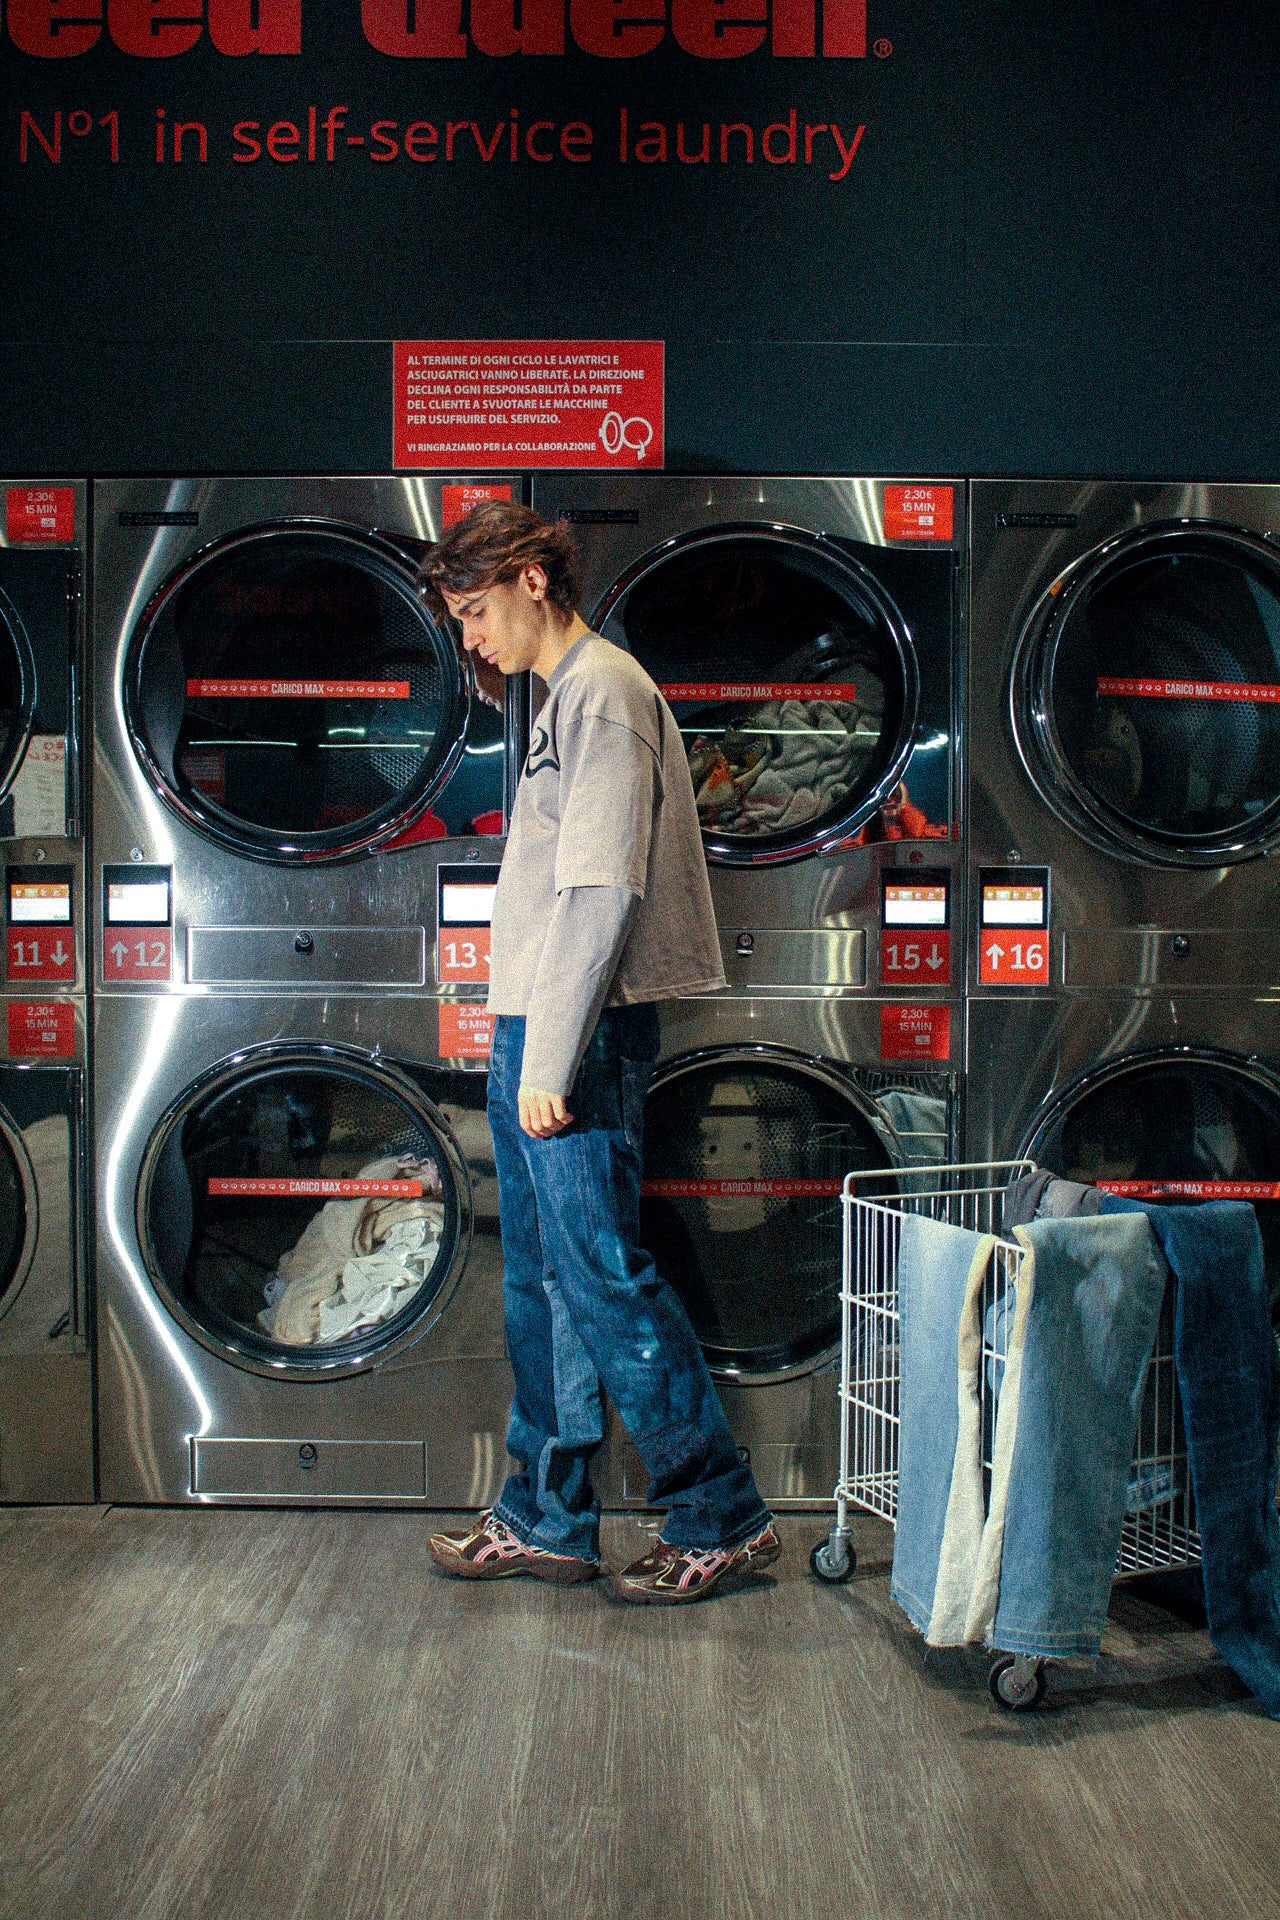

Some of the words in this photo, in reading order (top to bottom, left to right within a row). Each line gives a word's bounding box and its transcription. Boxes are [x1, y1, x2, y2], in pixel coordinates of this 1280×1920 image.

[155, 107, 208, 163] in
[232, 105, 595, 163] self-service
[619, 106, 866, 180] laundry
[407, 355, 421, 366] AL
[422, 355, 468, 365] TERMINE
[470, 355, 481, 365] DI
[483, 355, 510, 365] OGNI
[512, 355, 542, 365] CICLO
[544, 355, 556, 365] LE
[558, 355, 611, 365] LAVATRICI
[613, 355, 619, 365] E
[407, 370, 479, 380] ASCIUGATRICI
[480, 370, 519, 380] VANNO
[520, 370, 572, 380] LIBERATE.
[573, 370, 587, 380] LA
[589, 370, 645, 380] DIREZIONE
[407, 385, 452, 395] DECLINA
[453, 385, 481, 395] OGNI
[483, 383, 570, 395] RESPONSABILITÀ
[572, 385, 587, 394] DA
[589, 385, 622, 394] PARTE
[407, 400, 427, 410] DEL
[428, 400, 471, 410] CLIENTE
[472, 400, 480, 409] A
[482, 400, 537, 409] SVUOTARE
[539, 400, 552, 409] LE
[553, 400, 608, 409] MACCHINE
[407, 415, 427, 425] PER
[428, 414, 487, 425] USUFRUIRE
[489, 414, 508, 424] DEL
[510, 414, 561, 424] SERVIZIO.
[407, 443, 416, 452] VI
[417, 443, 482, 452] RINGRAZIAMO
[483, 443, 501, 451] PER
[502, 443, 513, 451] LA
[515, 442, 597, 451] COLLABORAZIONE
[25, 504, 35, 514] 15
[36, 504, 58, 514] MIN
[461, 502, 471, 512] 15
[903, 502, 912, 512] 15
[914, 502, 935, 512] MIN
[271, 683, 302, 694] CARICO
[304, 683, 324, 694] MAX
[720, 686, 750, 697] CARICO
[753, 686, 773, 697] MAX
[1165, 683, 1194, 695] CARICO
[1195, 685, 1213, 696] MAX
[13, 941, 43, 967] 11
[134, 941, 167, 967] 12
[444, 942, 477, 968] 13
[886, 944, 920, 970] 15
[1010, 944, 1044, 970] 16
[25, 1019, 36, 1028] 15
[37, 1019, 59, 1028] MIN
[458, 1020, 468, 1030] 15
[469, 1020, 490, 1030] MIN
[899, 1021, 909, 1031] 15
[910, 1021, 932, 1031] MIN
[289, 1181, 320, 1192] CARICO
[322, 1181, 340, 1192] MAX
[721, 1182, 750, 1193] CARICO
[753, 1182, 773, 1192] MAX
[1151, 1184, 1182, 1194] CARICO
[1183, 1184, 1202, 1194] MAX
